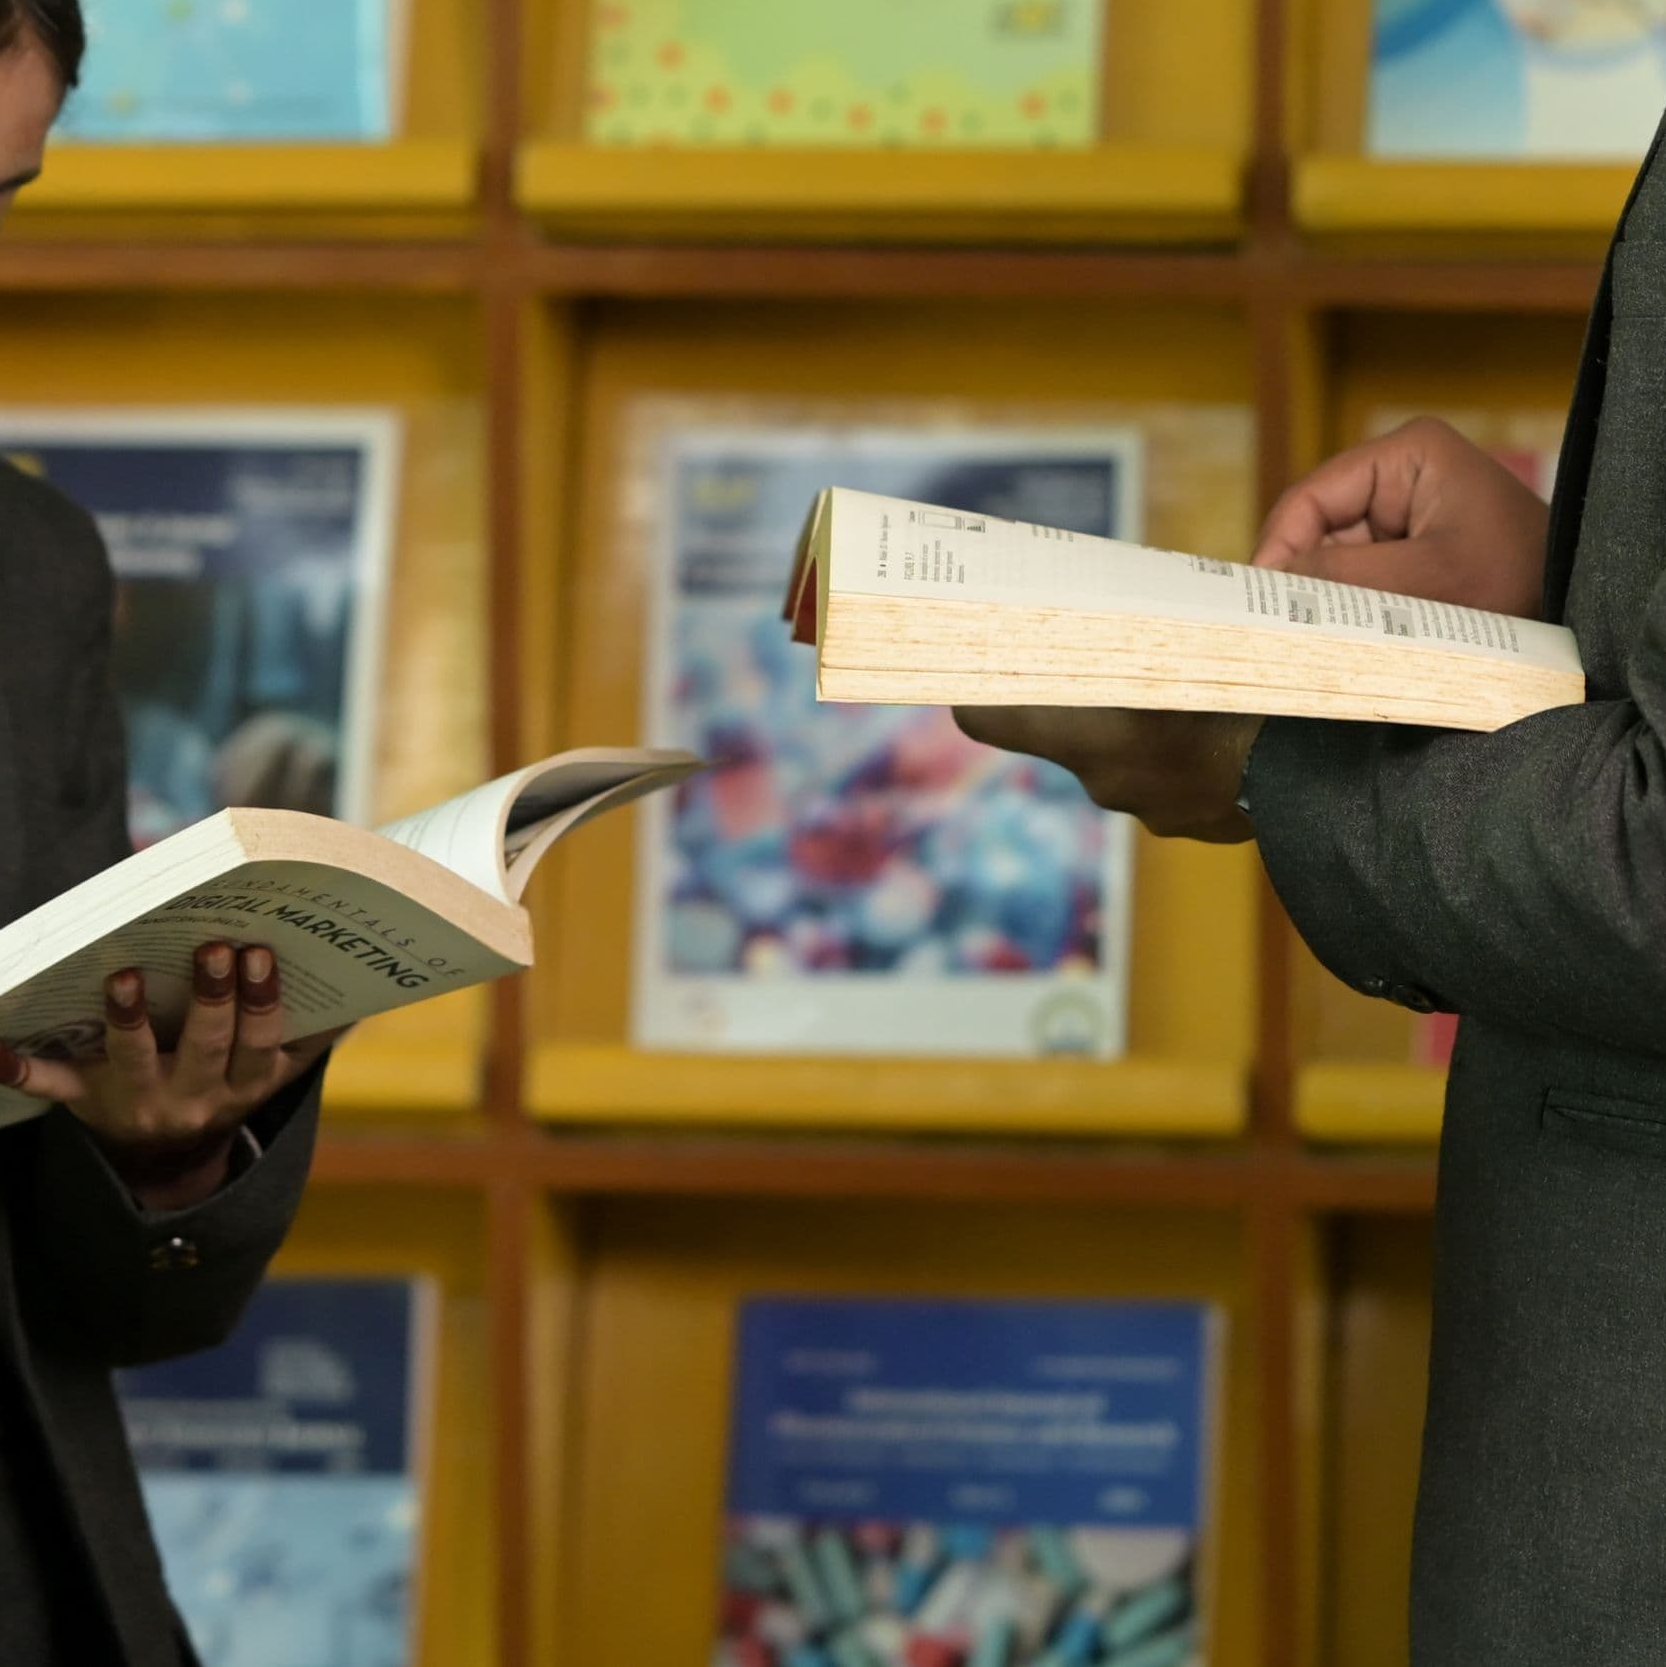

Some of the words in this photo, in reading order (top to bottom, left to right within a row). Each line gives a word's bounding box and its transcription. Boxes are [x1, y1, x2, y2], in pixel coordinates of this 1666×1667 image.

[165, 895, 272, 913] DIGITAL
[263, 904, 429, 990] MARKETING
[427, 957, 465, 977] OF
